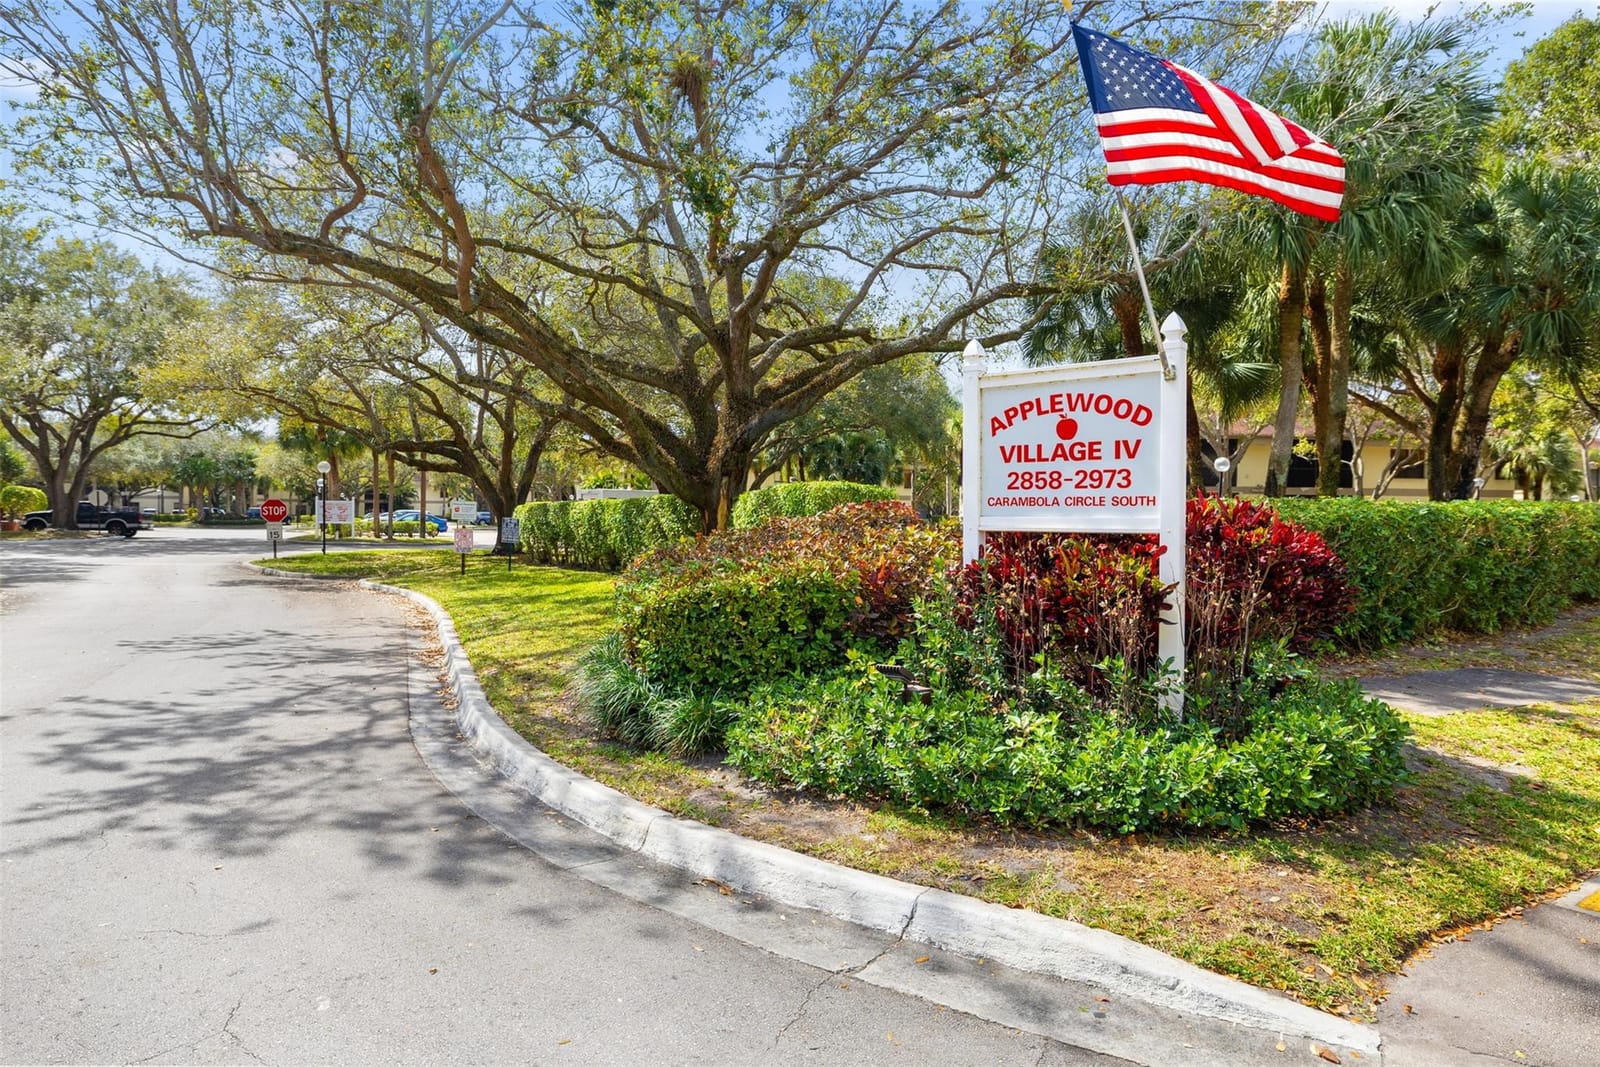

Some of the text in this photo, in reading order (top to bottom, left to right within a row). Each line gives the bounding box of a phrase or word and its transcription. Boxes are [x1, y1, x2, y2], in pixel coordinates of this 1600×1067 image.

[990, 393, 1153, 437] APPLEWOOD
[999, 439, 1142, 464] VILLAGE IV
[1007, 468, 1132, 490] 2858-2973
[987, 496, 1156, 507] CARAMBOLA CIRCLE SOUTH
[262, 506, 286, 516] STOP
[269, 531, 280, 539] 15
